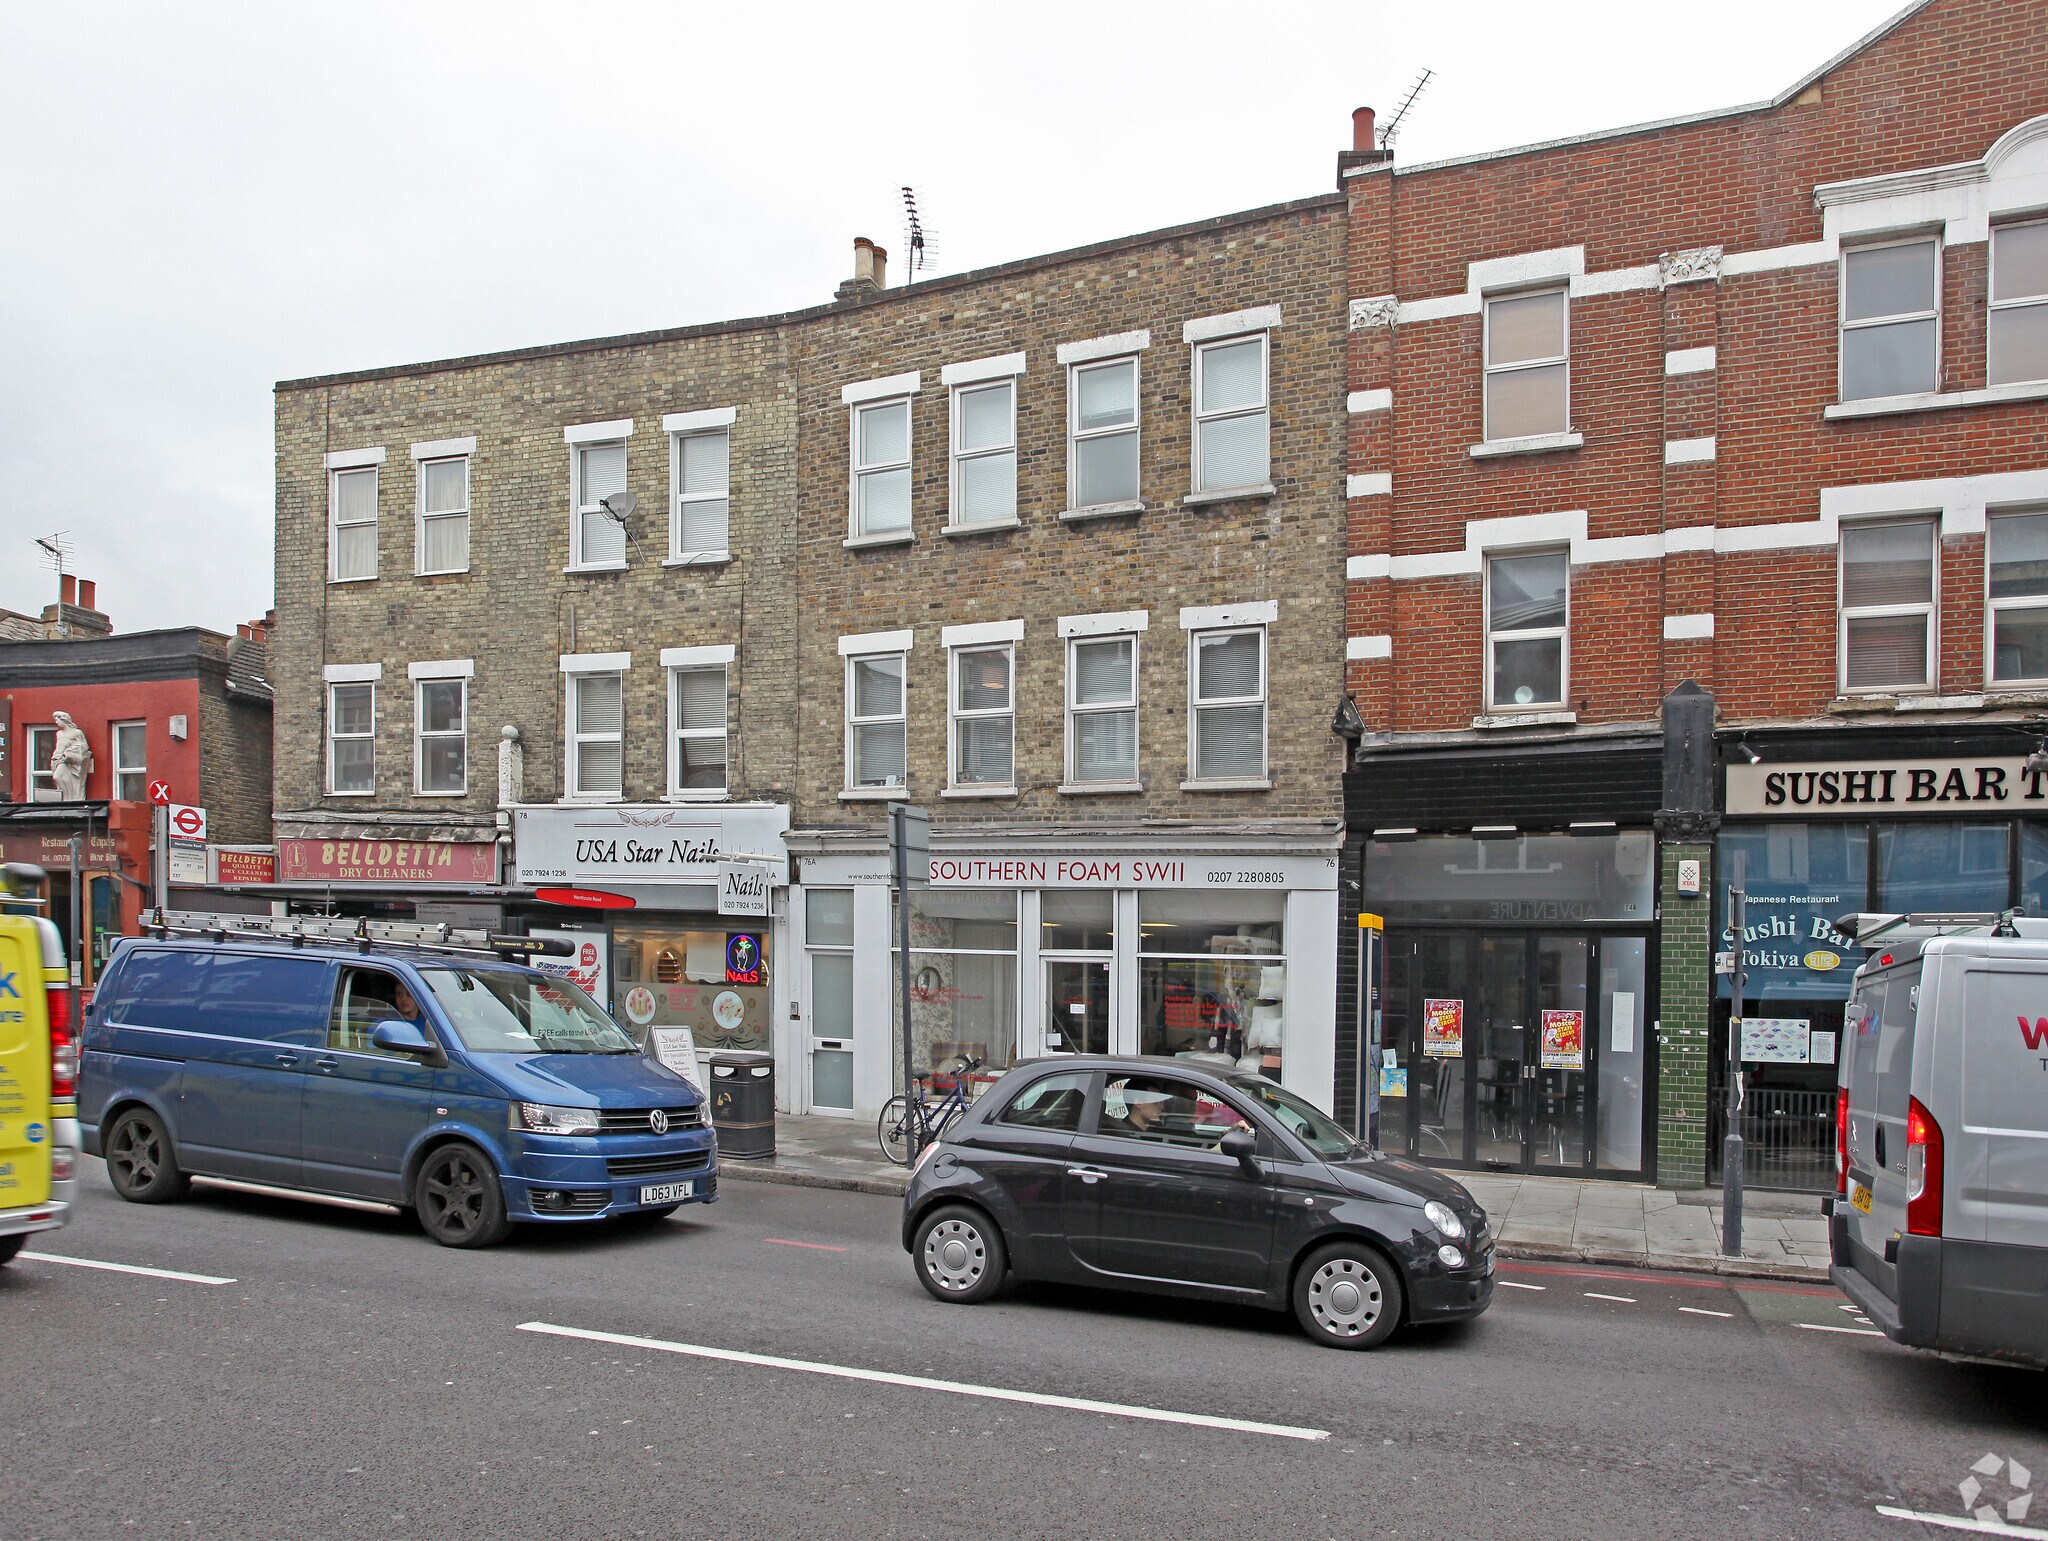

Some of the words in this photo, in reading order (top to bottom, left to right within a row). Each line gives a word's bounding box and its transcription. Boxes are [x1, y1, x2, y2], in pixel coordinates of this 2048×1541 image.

[154, 783, 169, 800] X
[1765, 770, 1897, 805] SUSHI
[1905, 767, 2008, 801] BAR
[322, 842, 452, 866] BELLDETTA
[576, 840, 618, 863] USA
[624, 839, 663, 863] Star
[668, 838, 720, 863] Nails
[221, 853, 273, 866] BELLDETTA
[1325, 859, 1335, 868] 76
[339, 868, 363, 878] DRY
[367, 868, 433, 878] CLEANERS
[930, 861, 1046, 881] SOUTHERN
[1057, 862, 1120, 881] FOAM
[1207, 872, 1232, 883] 0207
[1237, 872, 1285, 883] 2280805
[725, 873, 764, 896] Nails
[1744, 895, 1786, 904] Japanese
[1789, 895, 1840, 904] Restaurant
[1809, 917, 1854, 951] Bar
[1742, 950, 1799, 969] Tokiya
[726, 969, 758, 983] NAILS
[1432, 1009, 1456, 1017] MOSCOW
[1437, 1019, 1456, 1027] CIRCUS
[1550, 1021, 1576, 1029] MOSCOW
[538, 1029, 554, 1037] FREE
[555, 1029, 568, 1037] calls
[585, 1028, 598, 1036] USA
[1556, 1030, 1575, 1039] CIRCUS
[645, 1186, 670, 1201] LD63
[672, 1184, 689, 1198] VFL
